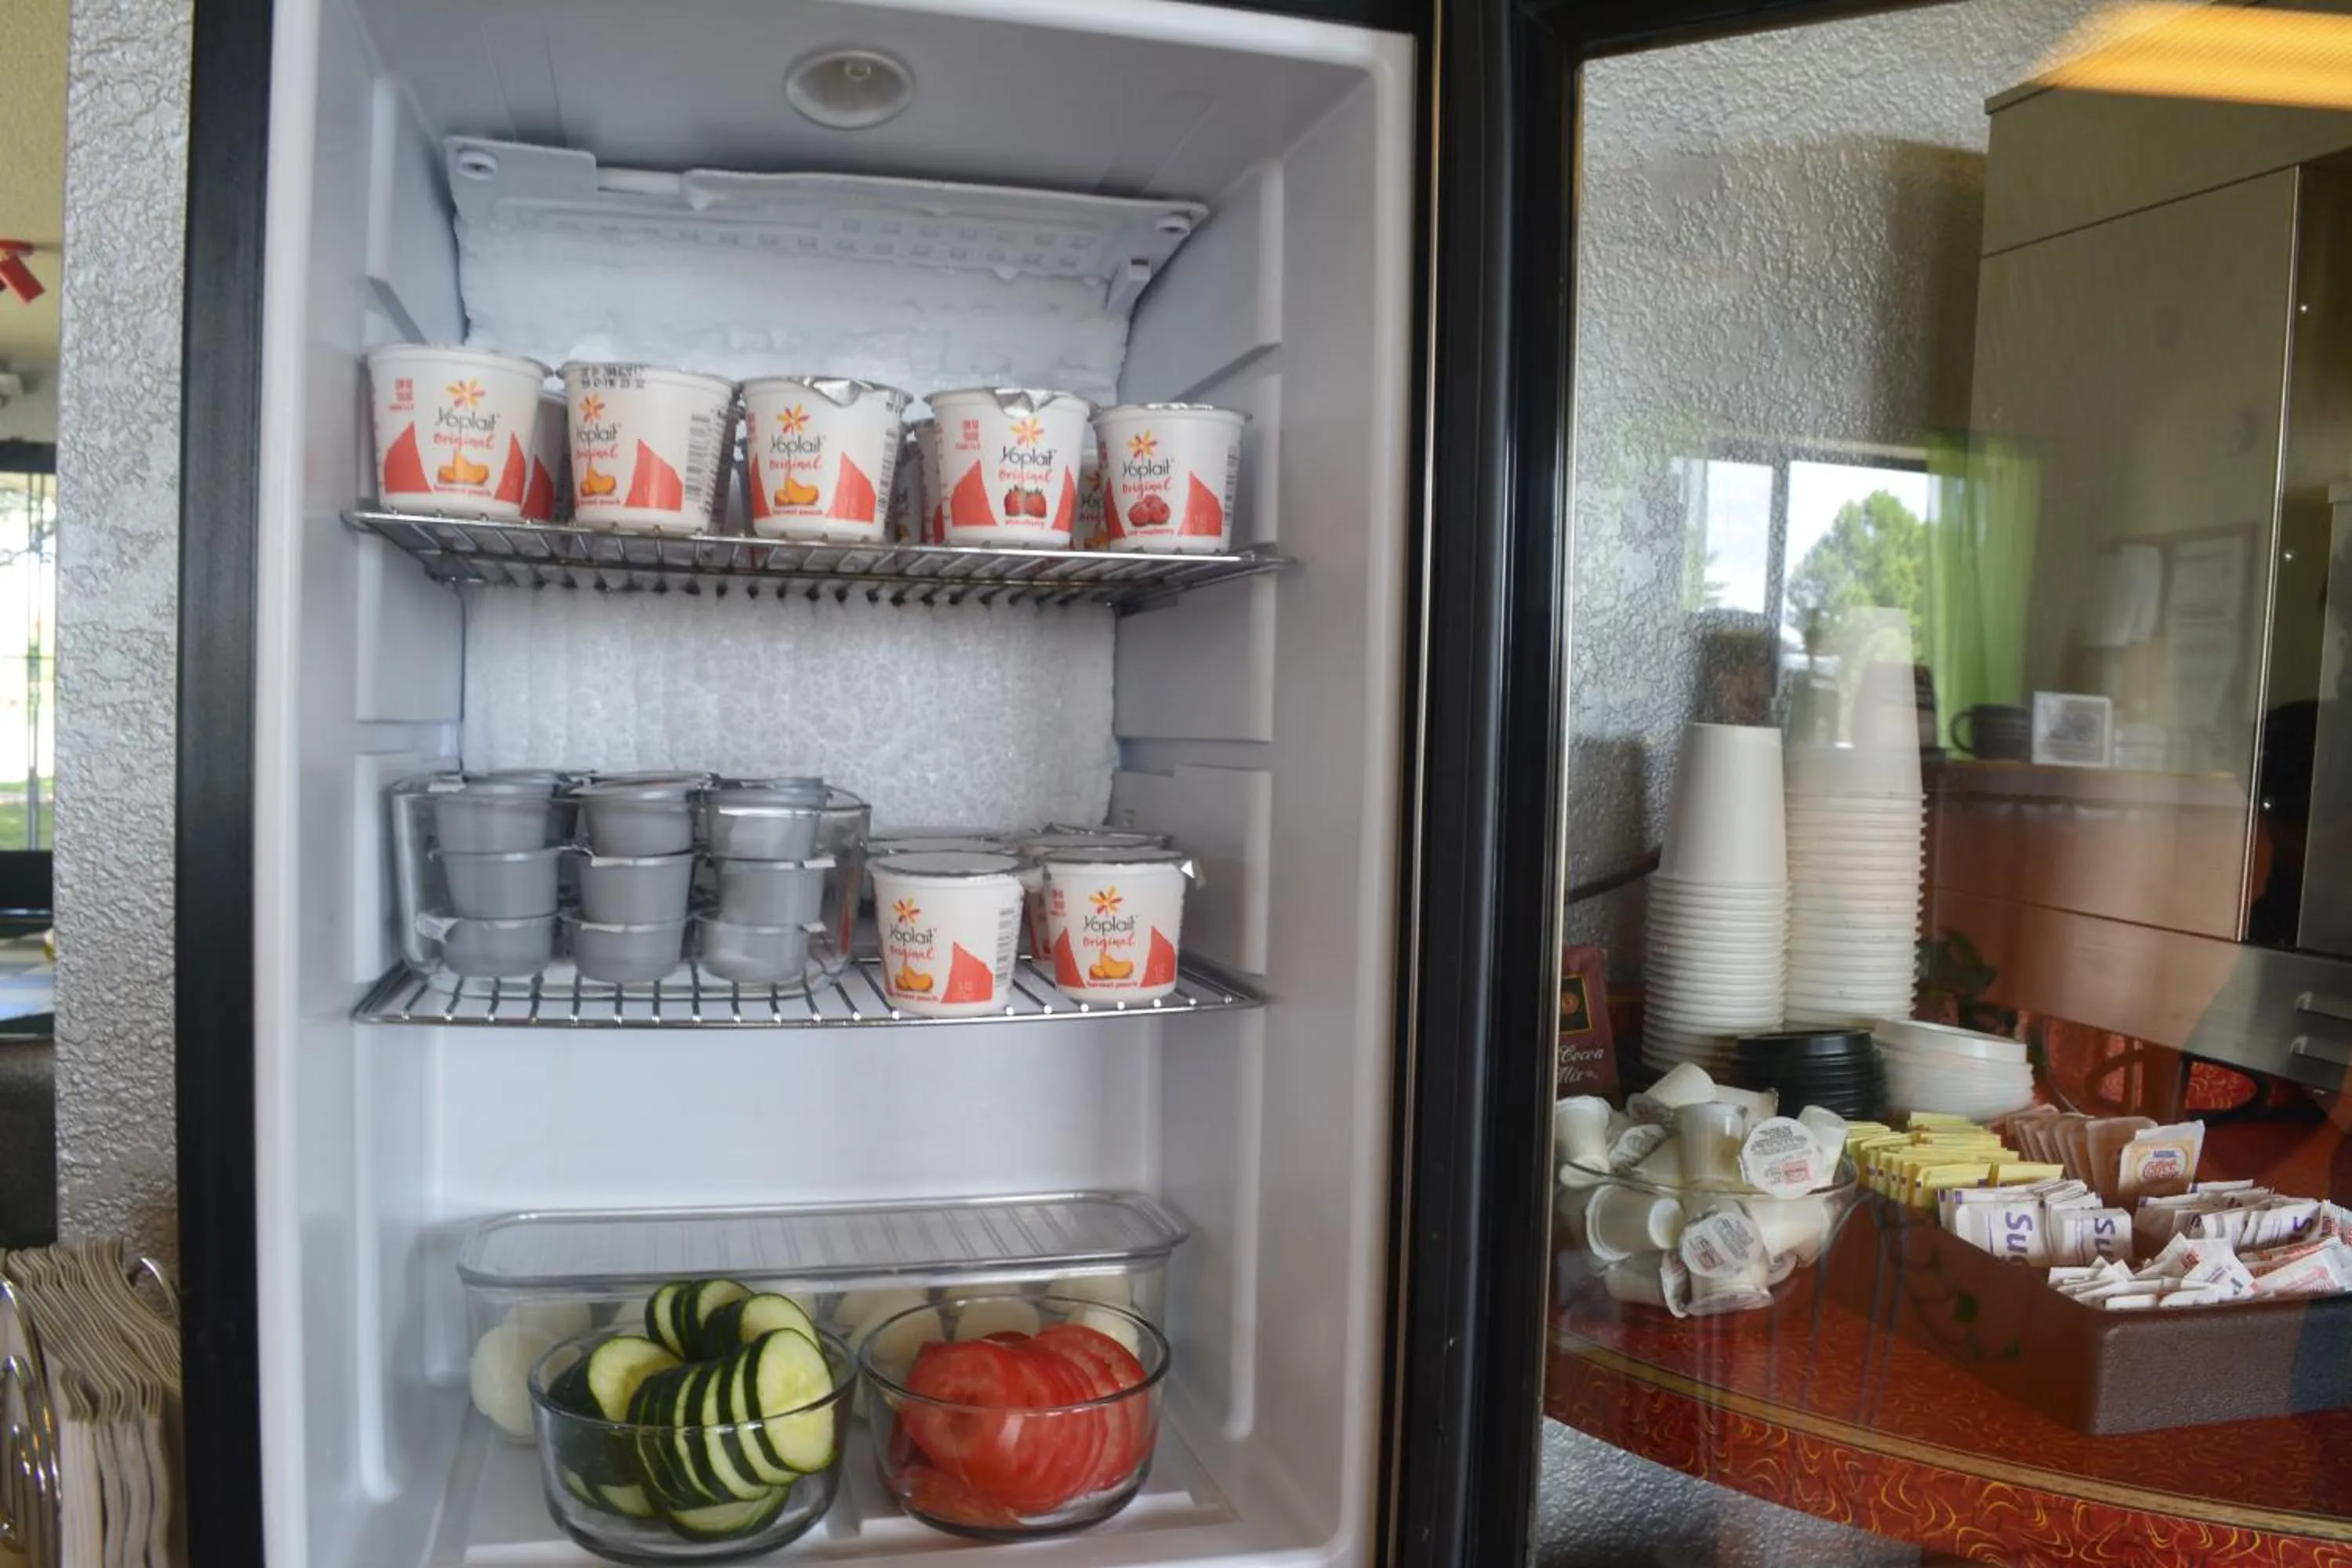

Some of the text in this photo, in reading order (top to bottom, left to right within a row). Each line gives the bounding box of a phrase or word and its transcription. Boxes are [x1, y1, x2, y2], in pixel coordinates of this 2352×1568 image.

[435, 407, 495, 434] Yoplait
[575, 423, 618, 445] Yoplait
[769, 433, 821, 456] Yoplait
[999, 445, 1053, 469] Yoplait
[1122, 458, 1171, 481] Yoplait
[890, 923, 933, 946] Yoplait
[1083, 915, 1135, 935] Yoplait
[1560, 1044, 1604, 1064] Cocoa
